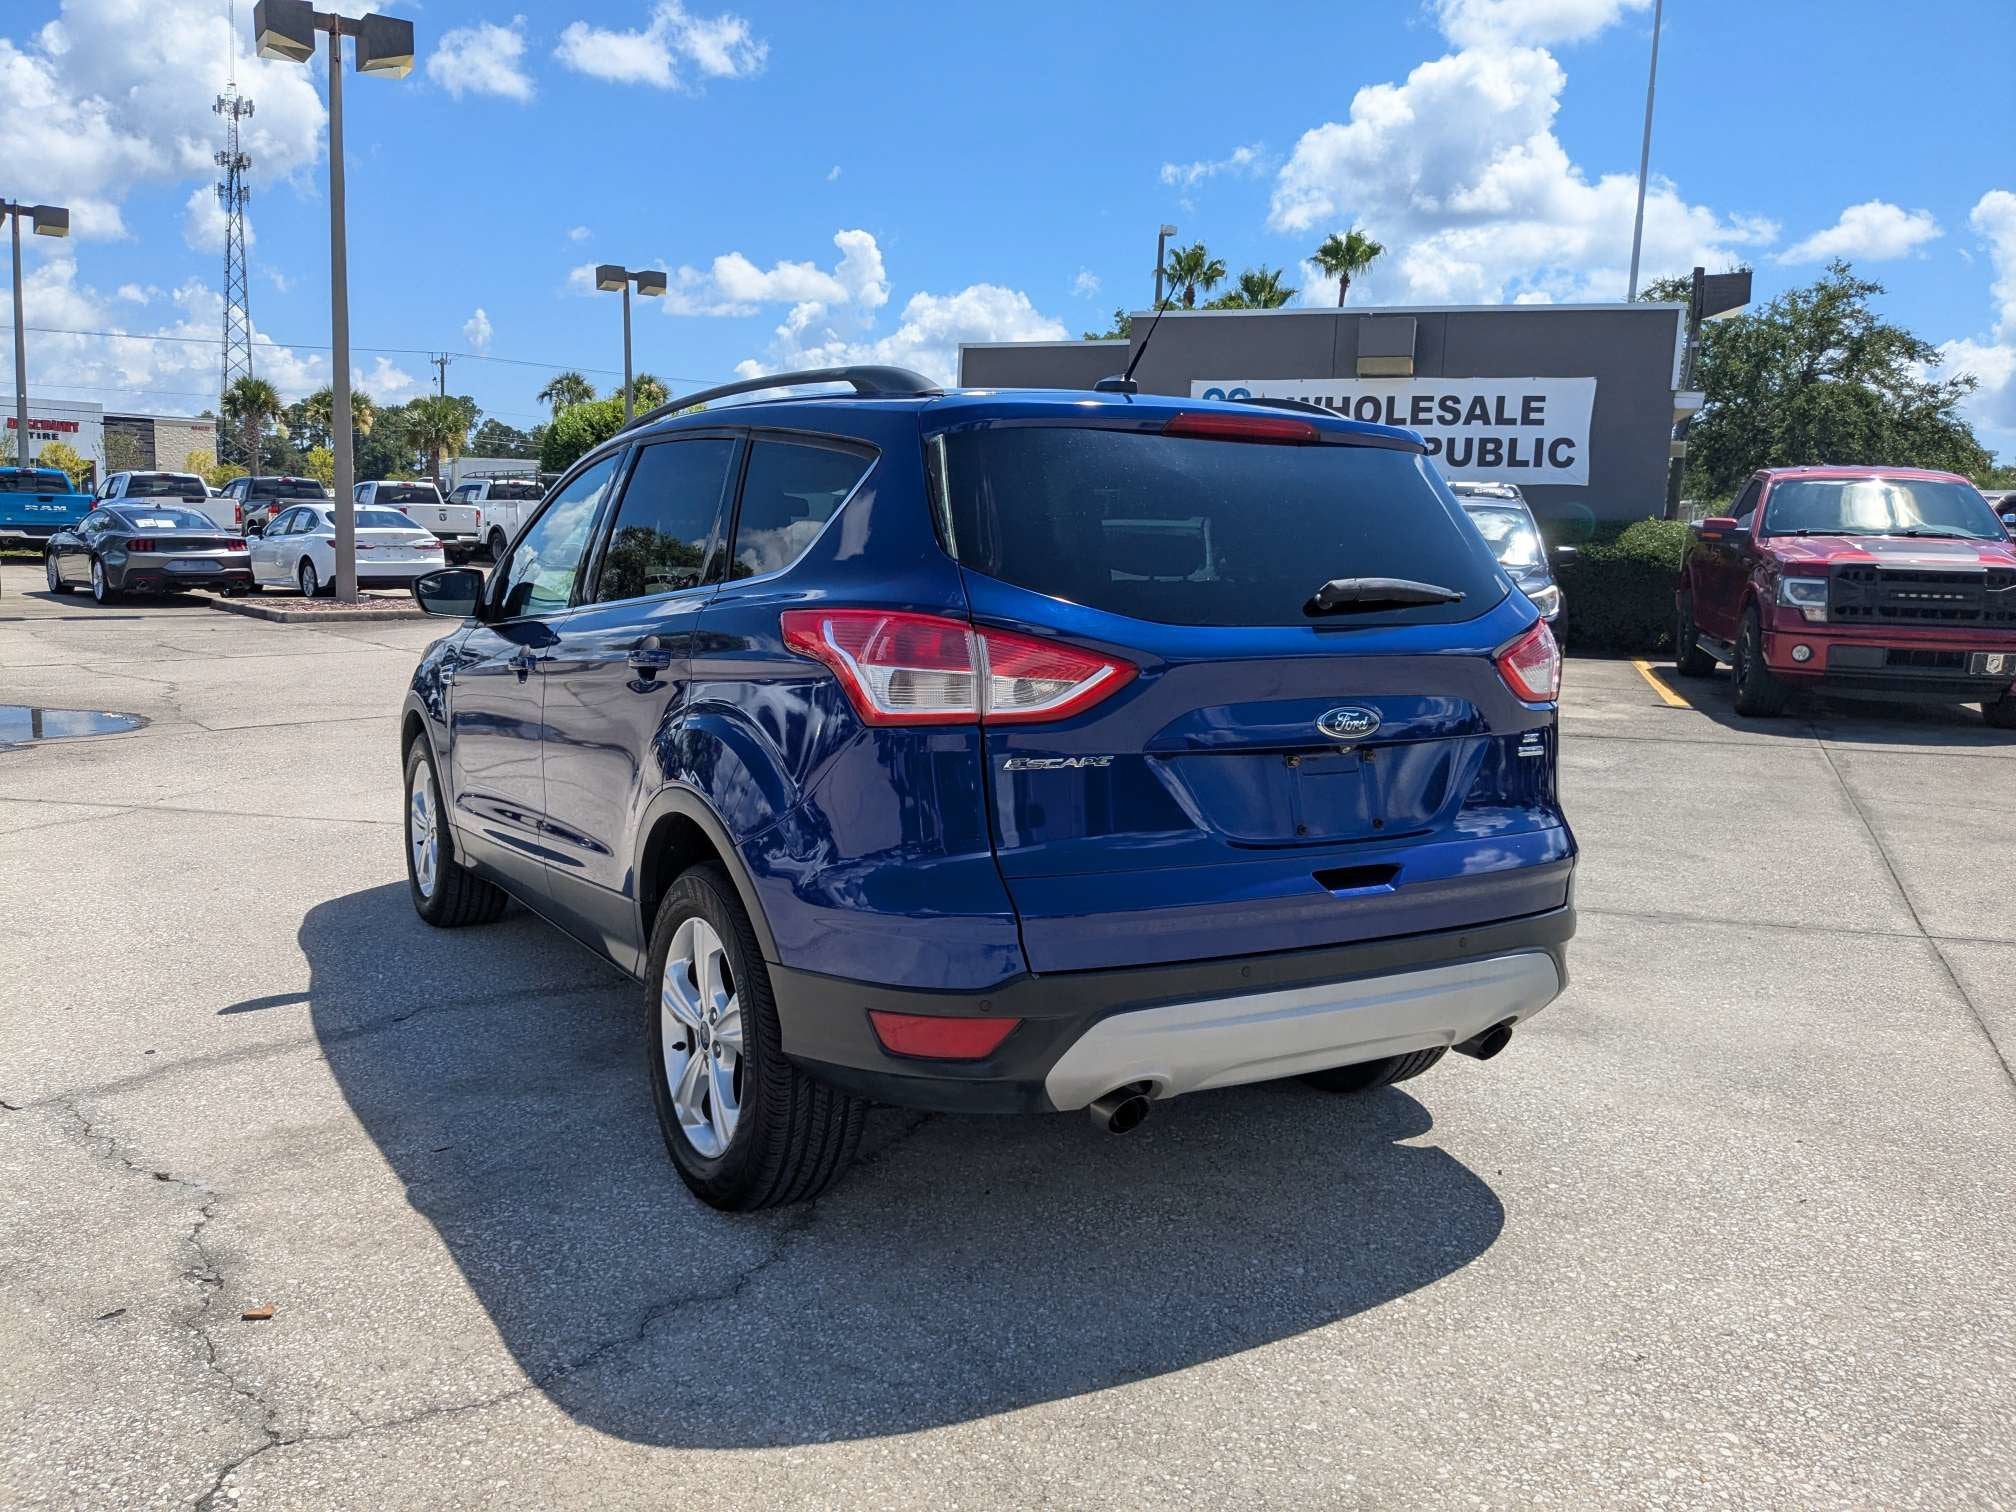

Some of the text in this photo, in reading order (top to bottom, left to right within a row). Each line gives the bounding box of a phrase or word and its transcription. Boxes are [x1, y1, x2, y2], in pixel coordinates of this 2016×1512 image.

[28, 432, 60, 441] TIRE
[24, 504, 67, 512] RAM
[1335, 712, 1369, 731] Ford
[1003, 756, 1115, 771] ESCAPE
